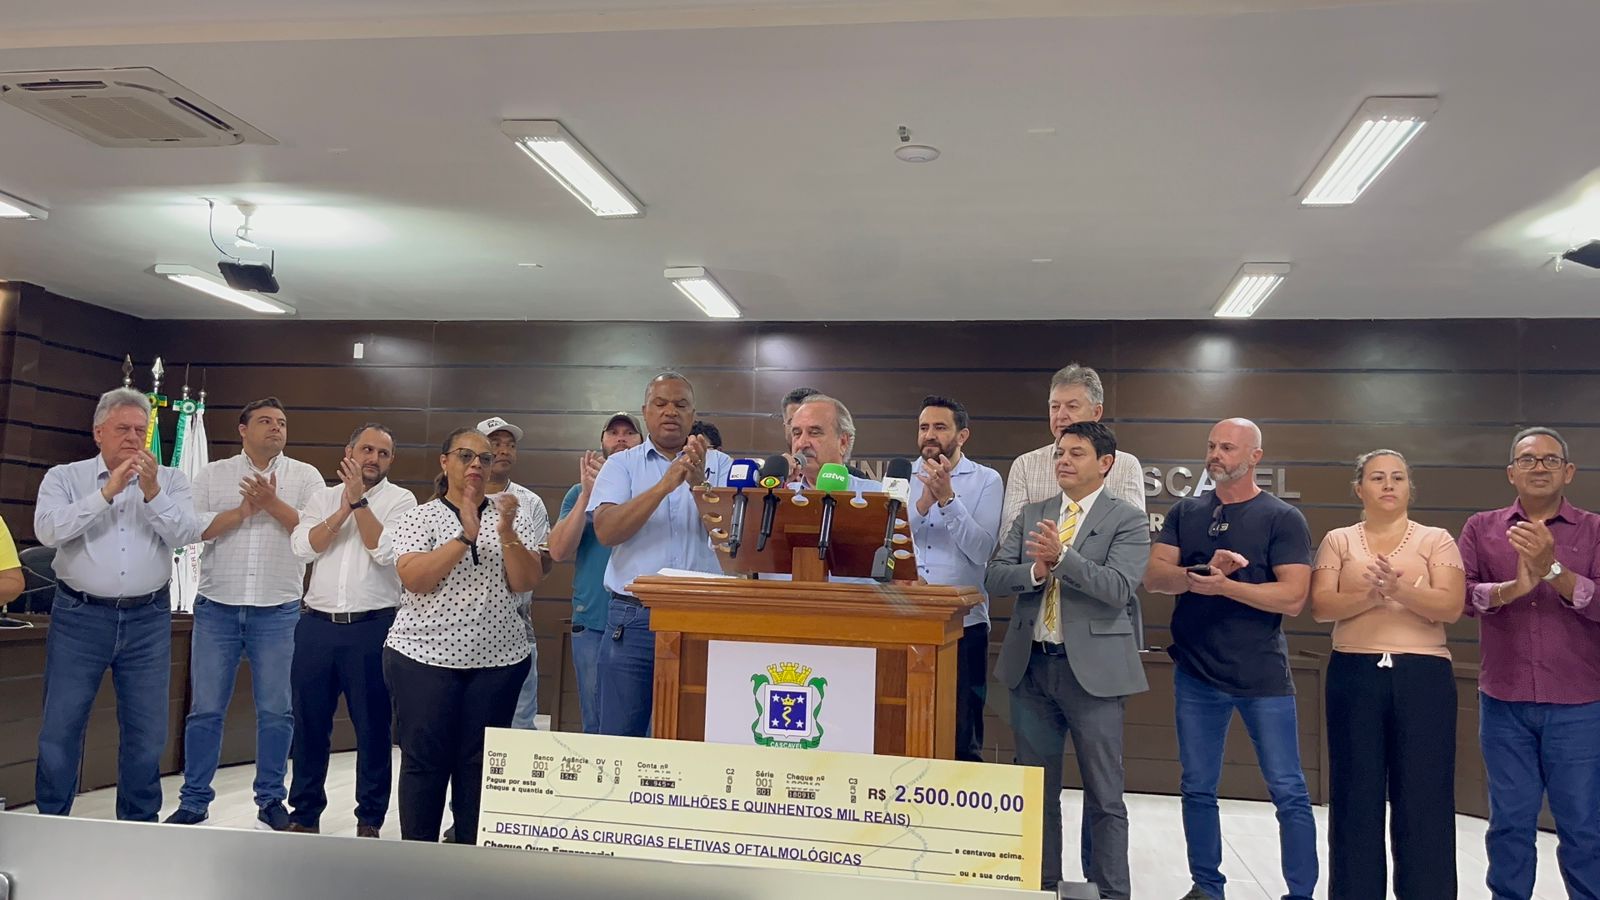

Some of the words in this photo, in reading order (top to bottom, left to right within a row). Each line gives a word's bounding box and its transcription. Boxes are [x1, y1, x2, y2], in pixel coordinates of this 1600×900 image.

[1143, 466, 1300, 498] SCAEL
[486, 776, 506, 784] Pague
[487, 750, 508, 759] Comp
[533, 754, 555, 762] Banco
[561, 756, 589, 765] Agência
[637, 761, 658, 769] Conta
[755, 770, 774, 778] Série
[786, 773, 814, 781] Cheque
[848, 777, 858, 785] C3
[532, 760, 549, 771] 001
[755, 777, 773, 788] 001
[485, 784, 510, 792] cheque
[868, 788, 886, 801] R$
[895, 785, 1024, 813] 2.500.000,00
[629, 791, 665, 805] (DOIS
[668, 794, 727, 810] MILHÕES
[732, 799, 740, 811] E
[743, 800, 833, 819] QUINHENTOS
[836, 808, 860, 821] MIL
[864, 810, 911, 828] REAIS)
[496, 822, 568, 840] DESTINADO
[572, 825, 589, 841] ÀS
[592, 831, 664, 848] CIRURGIAS
[668, 837, 731, 855] ELETIVAS
[734, 843, 862, 866] OFTALMOLÓGICAS
[962, 849, 996, 858] centavos
[999, 852, 1025, 860] acima.
[996, 874, 1024, 882] ordem.
